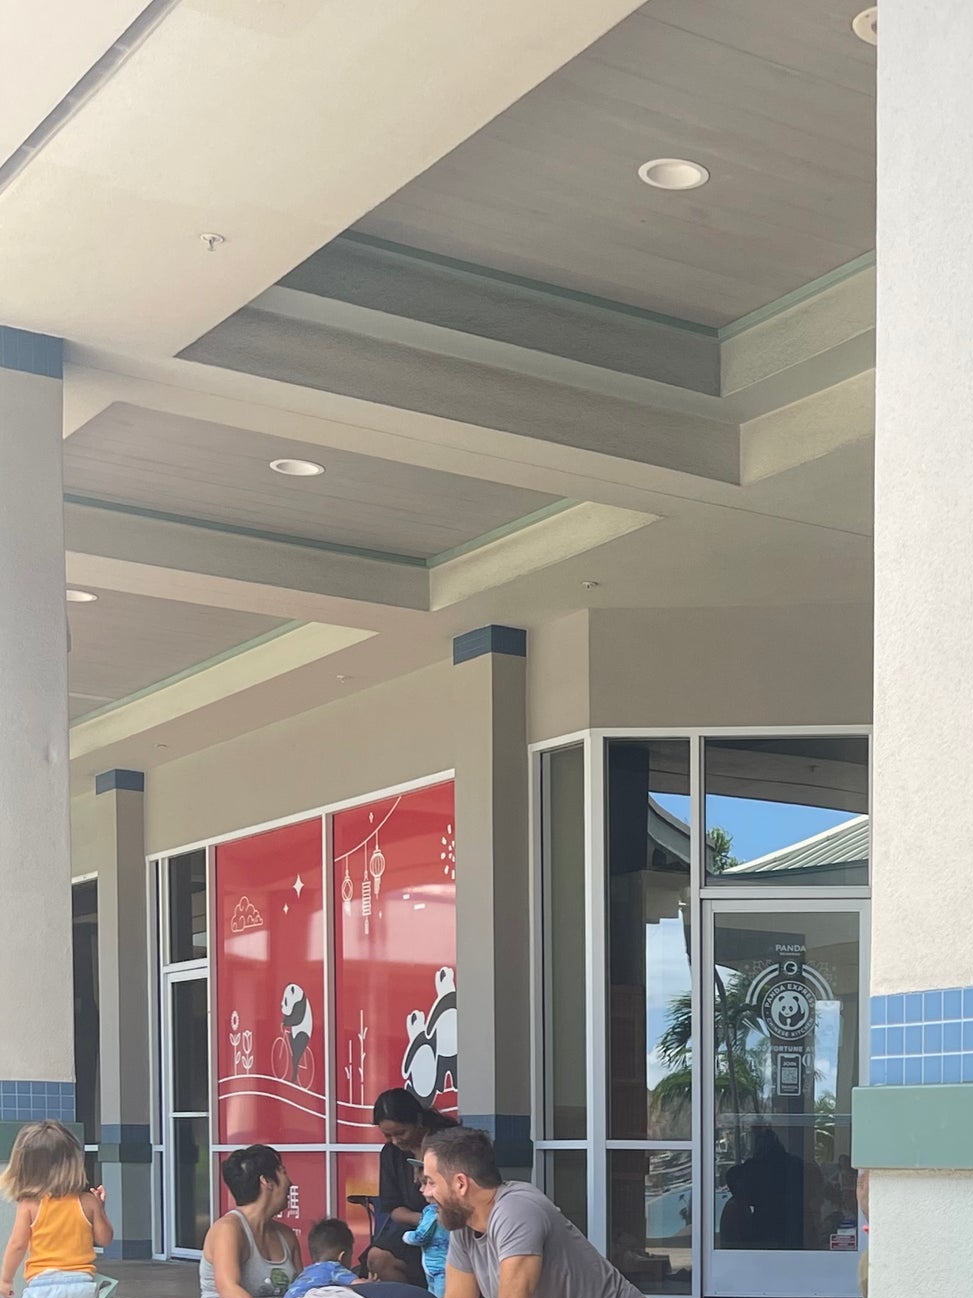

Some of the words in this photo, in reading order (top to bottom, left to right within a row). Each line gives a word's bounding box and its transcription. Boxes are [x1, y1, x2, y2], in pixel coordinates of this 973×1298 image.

[775, 944, 806, 952] PANDA
[764, 983, 786, 1008] PANDA
[787, 983, 815, 1008] EXPRESS
[766, 1018, 790, 1037] CHINESE
[791, 1018, 814, 1037] KITCHEN
